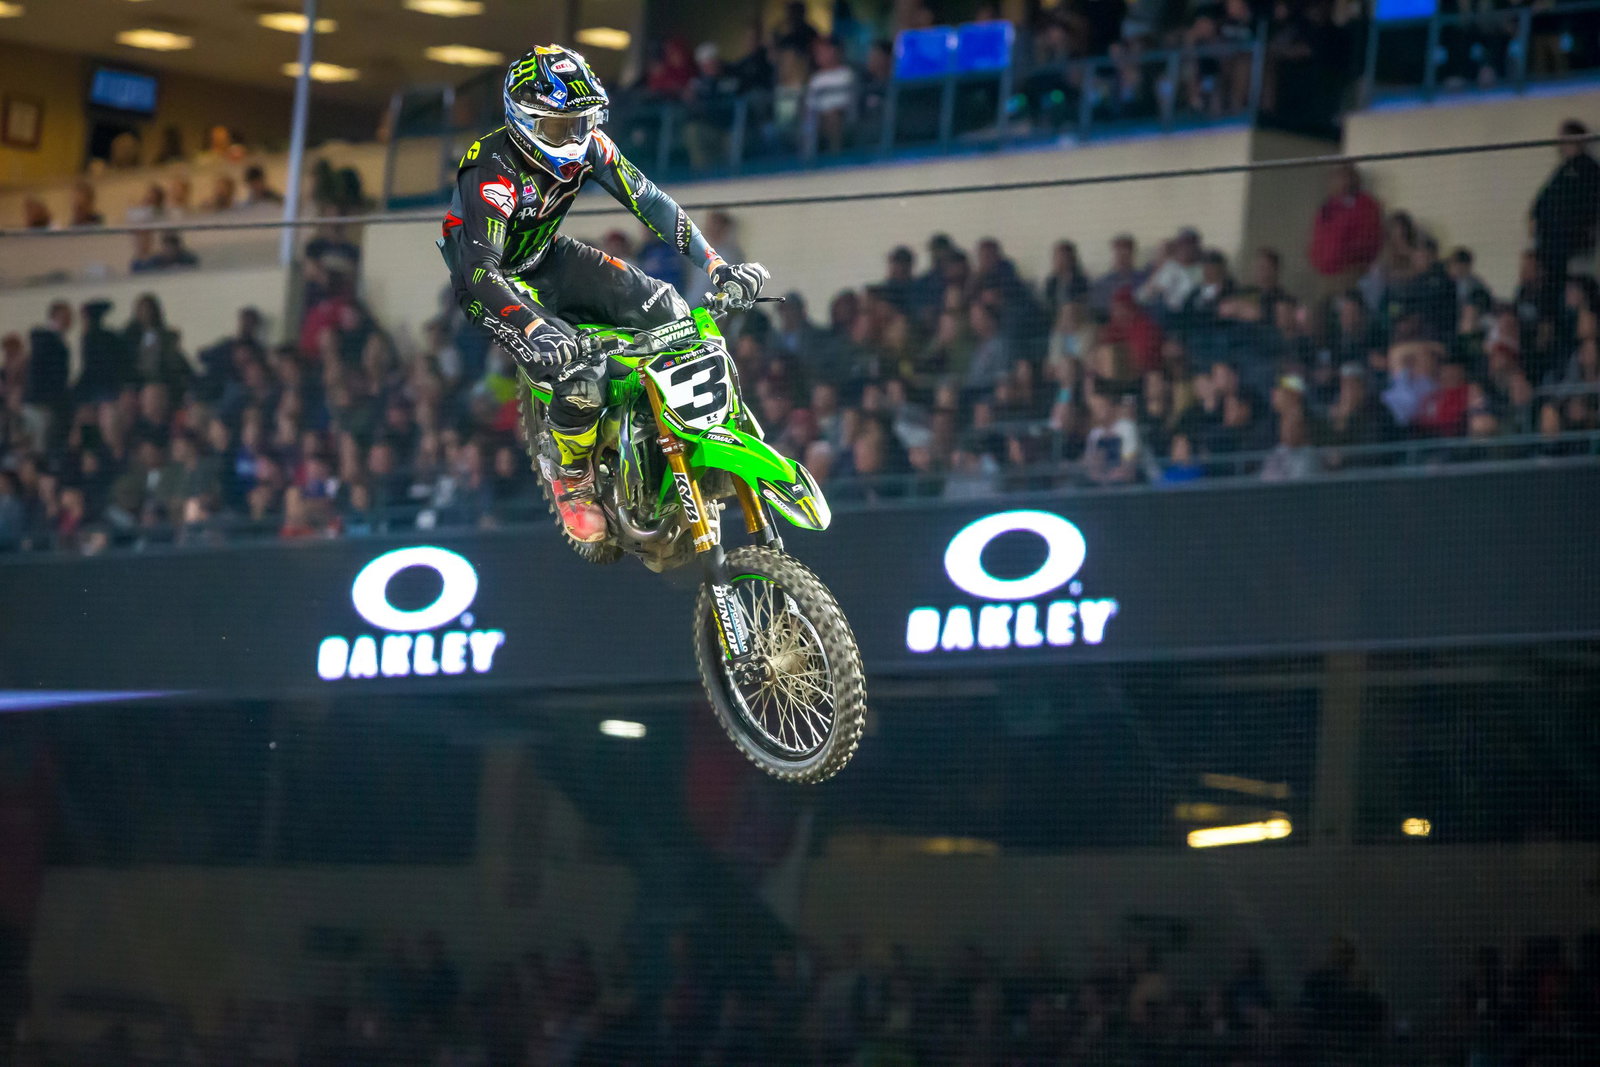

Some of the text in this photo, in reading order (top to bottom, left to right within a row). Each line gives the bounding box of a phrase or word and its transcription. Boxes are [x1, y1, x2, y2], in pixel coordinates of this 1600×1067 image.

[670, 354, 728, 422] 3
[706, 434, 735, 444] TOMAC
[712, 585, 740, 655] DUNLOP
[732, 608, 748, 653] CARRILLO
[906, 597, 1119, 653] OAKLEY
[317, 628, 506, 681] OAKLEY
